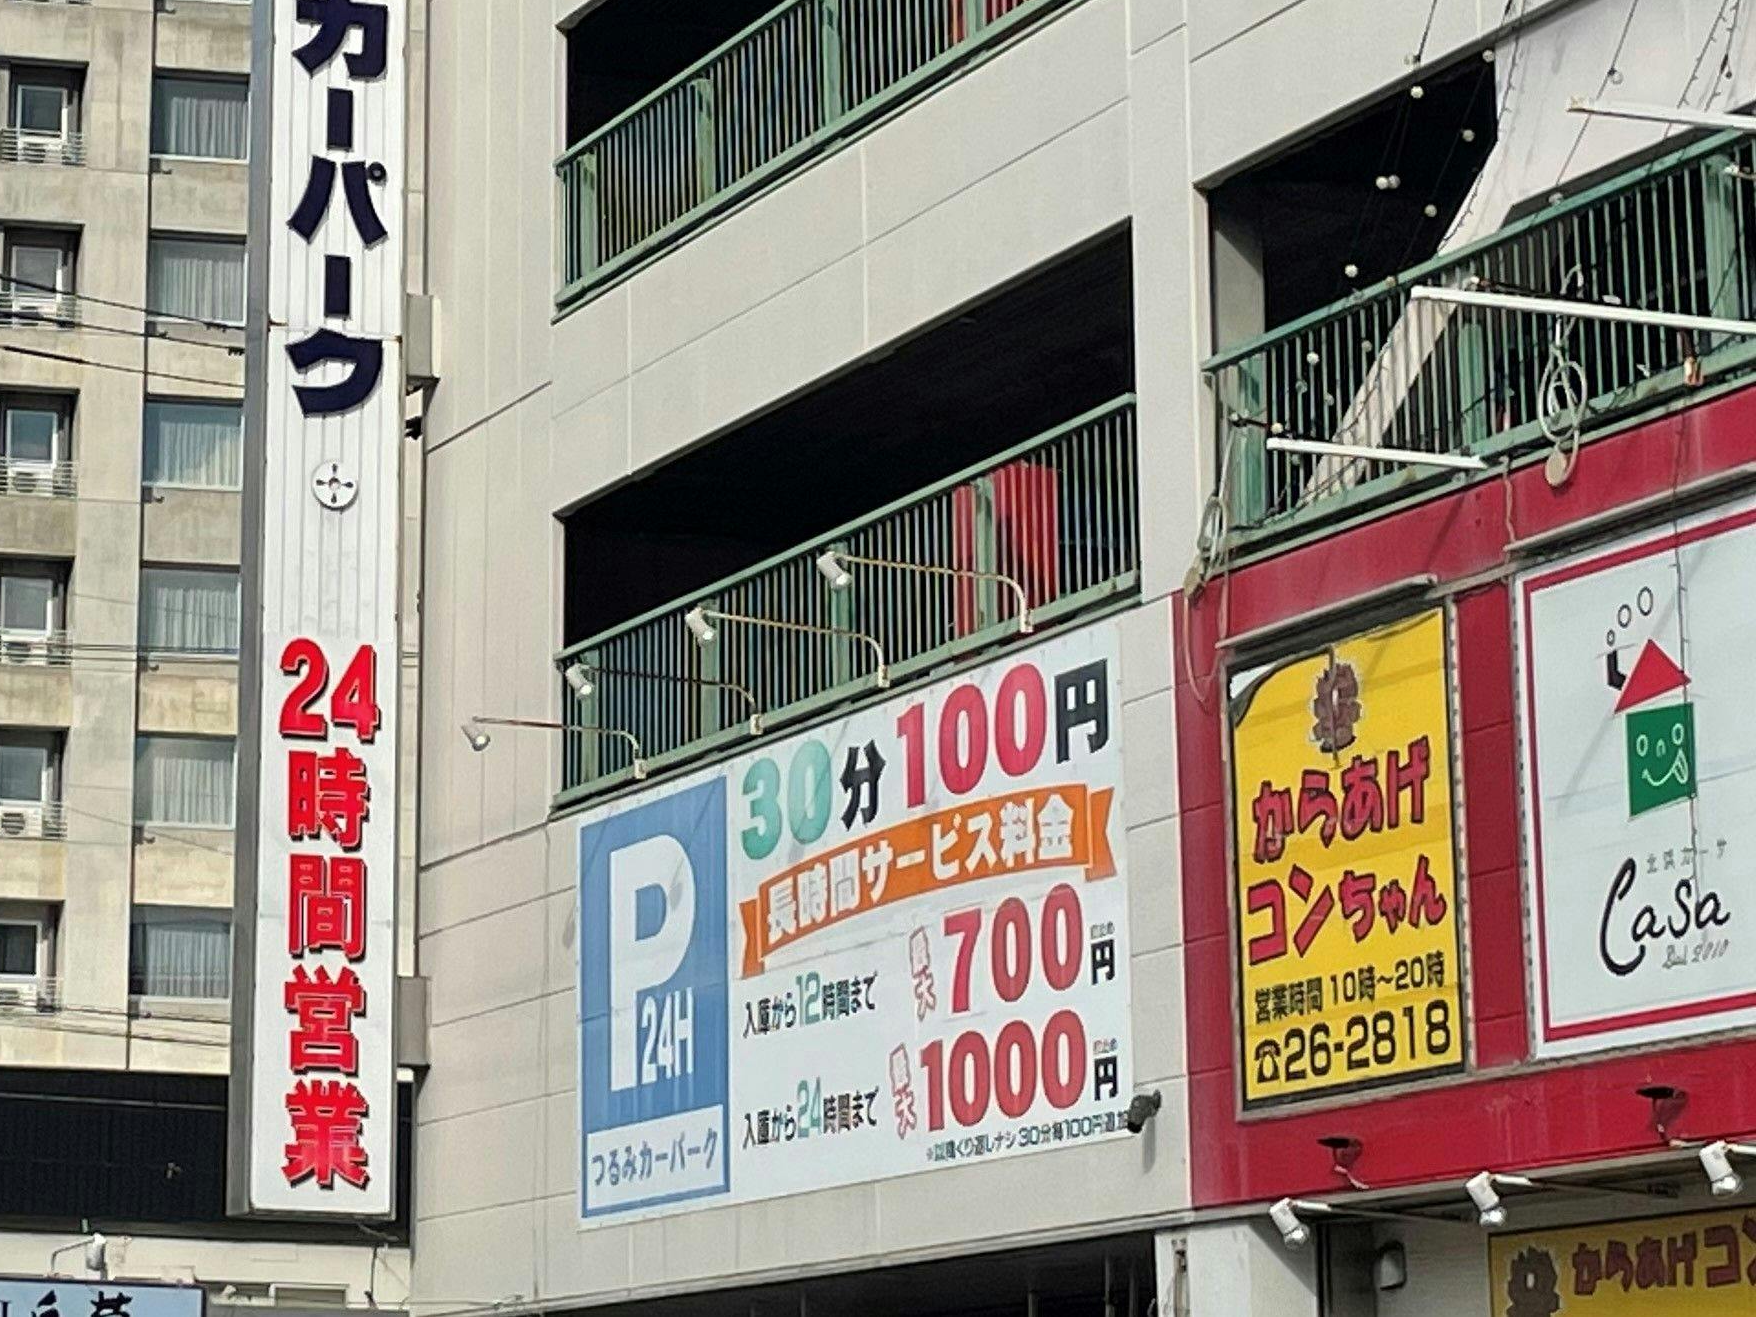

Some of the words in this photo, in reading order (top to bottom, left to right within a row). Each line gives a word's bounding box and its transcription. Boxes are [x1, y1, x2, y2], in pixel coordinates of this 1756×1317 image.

[740, 657, 1109, 860] 30分100円
[1253, 735, 1431, 865] からあげ
[278, 637, 382, 1191] 24時間営業
[766, 793, 1074, 943] 長時間サービス料金
[1246, 854, 1448, 967] コンちゃん
[1599, 857, 1732, 977] Casa
[609, 833, 696, 1093] P
[1254, 976, 1324, 1026] 営業時間
[641, 986, 694, 1085] 24H
[1284, 998, 1452, 1083] 26-2818
[592, 1127, 718, 1186] つるみカーパーク
